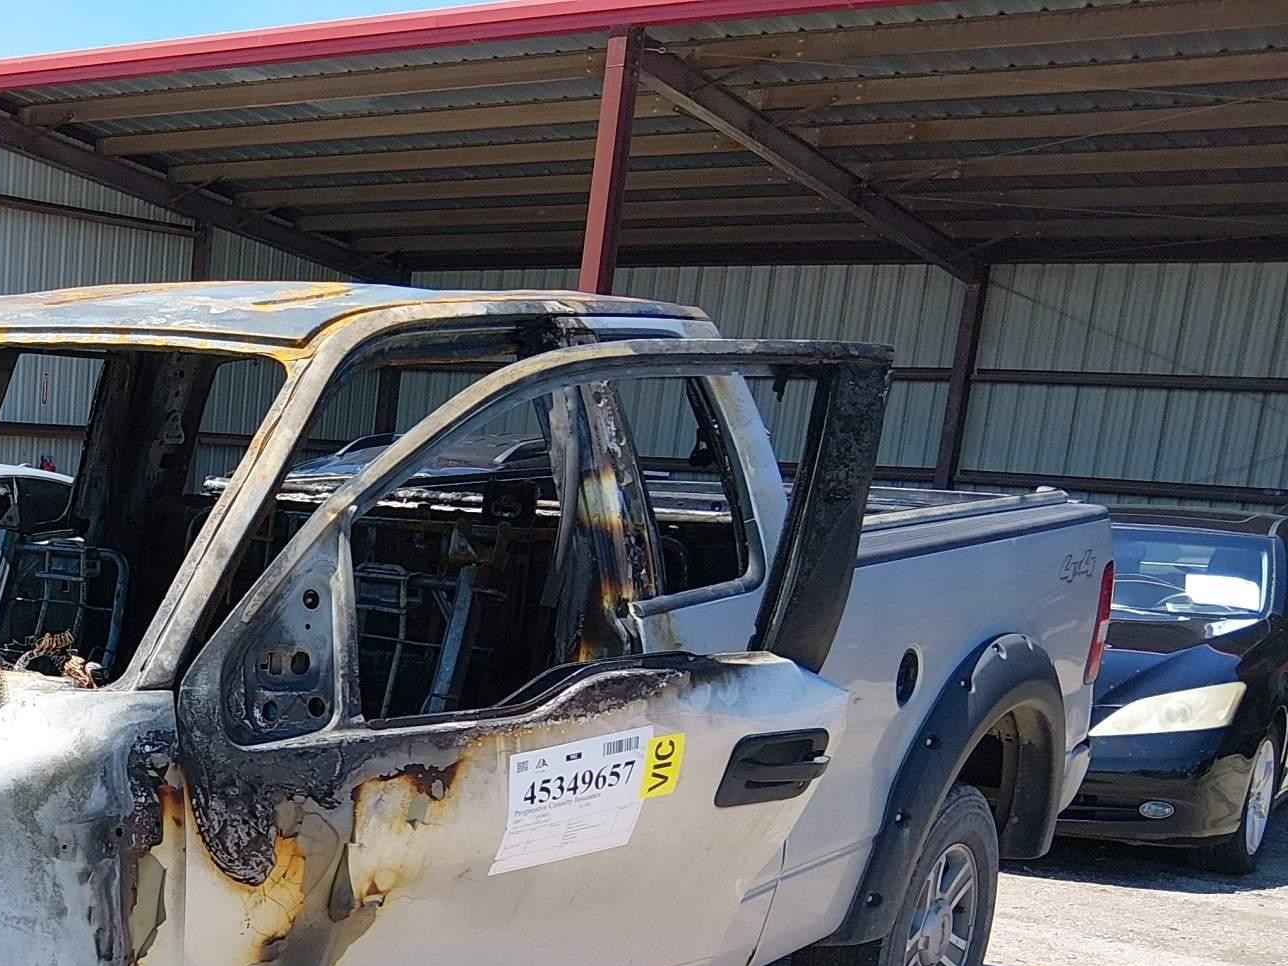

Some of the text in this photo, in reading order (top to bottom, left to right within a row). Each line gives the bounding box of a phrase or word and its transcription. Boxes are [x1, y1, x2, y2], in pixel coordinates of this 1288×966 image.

[1059, 549, 1097, 583] 4x4
[523, 760, 636, 805] 45349657
[647, 739, 675, 793] VIC
